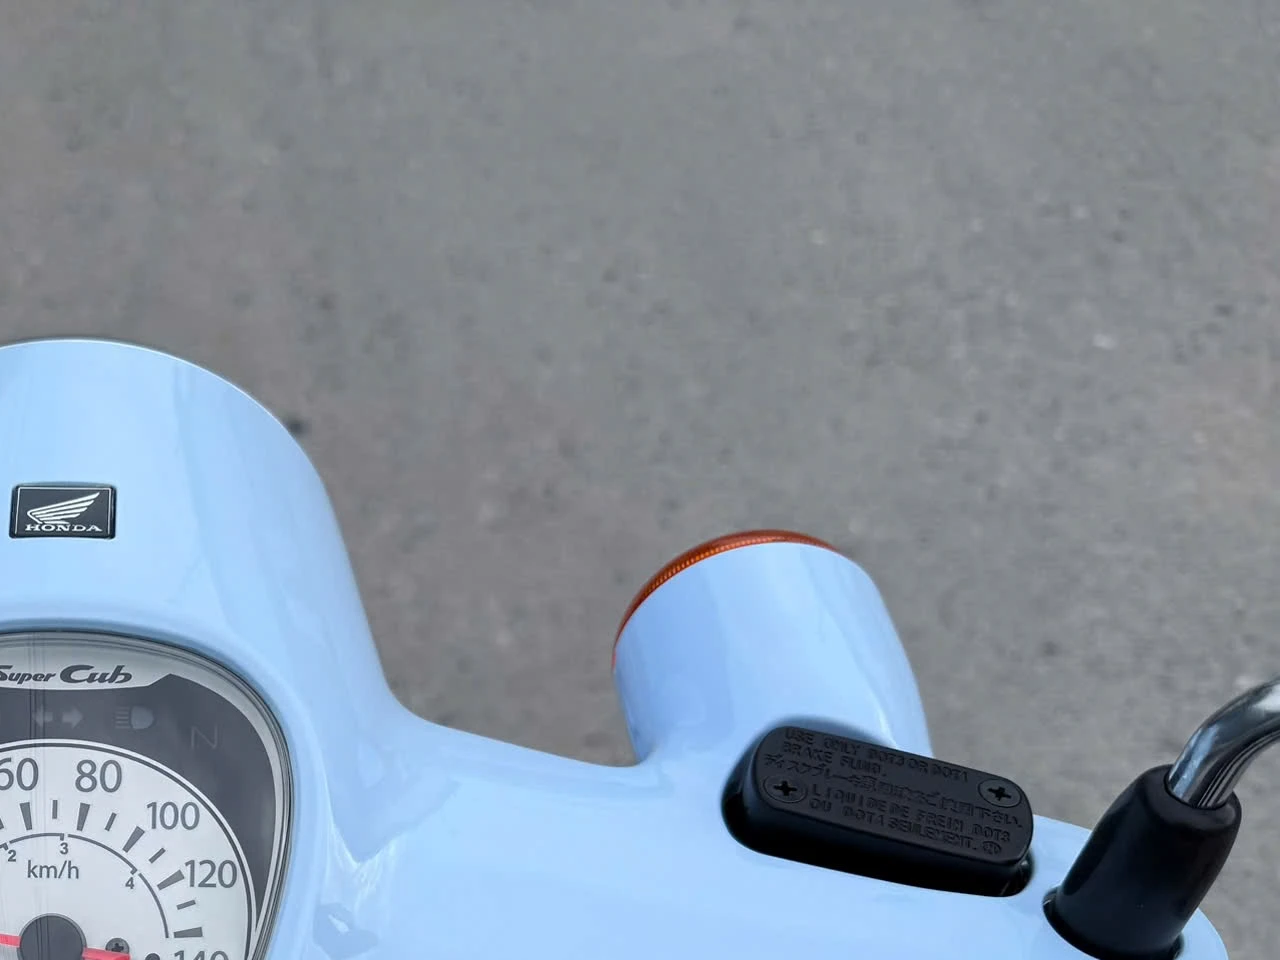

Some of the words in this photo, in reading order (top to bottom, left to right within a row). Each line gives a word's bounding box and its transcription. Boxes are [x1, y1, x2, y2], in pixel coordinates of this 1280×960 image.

[24, 523, 103, 532] HONDA
[59, 664, 133, 684] Cub
[785, 728, 814, 744] USE
[824, 737, 860, 754] ONLY
[783, 741, 833, 763] BRAKE
[75, 759, 123, 793] 80
[147, 801, 200, 830] 100
[7, 850, 17, 862] 2
[59, 842, 69, 855] 3
[27, 860, 79, 879] km/h
[185, 859, 238, 888] 120
[125, 877, 135, 890] 4
